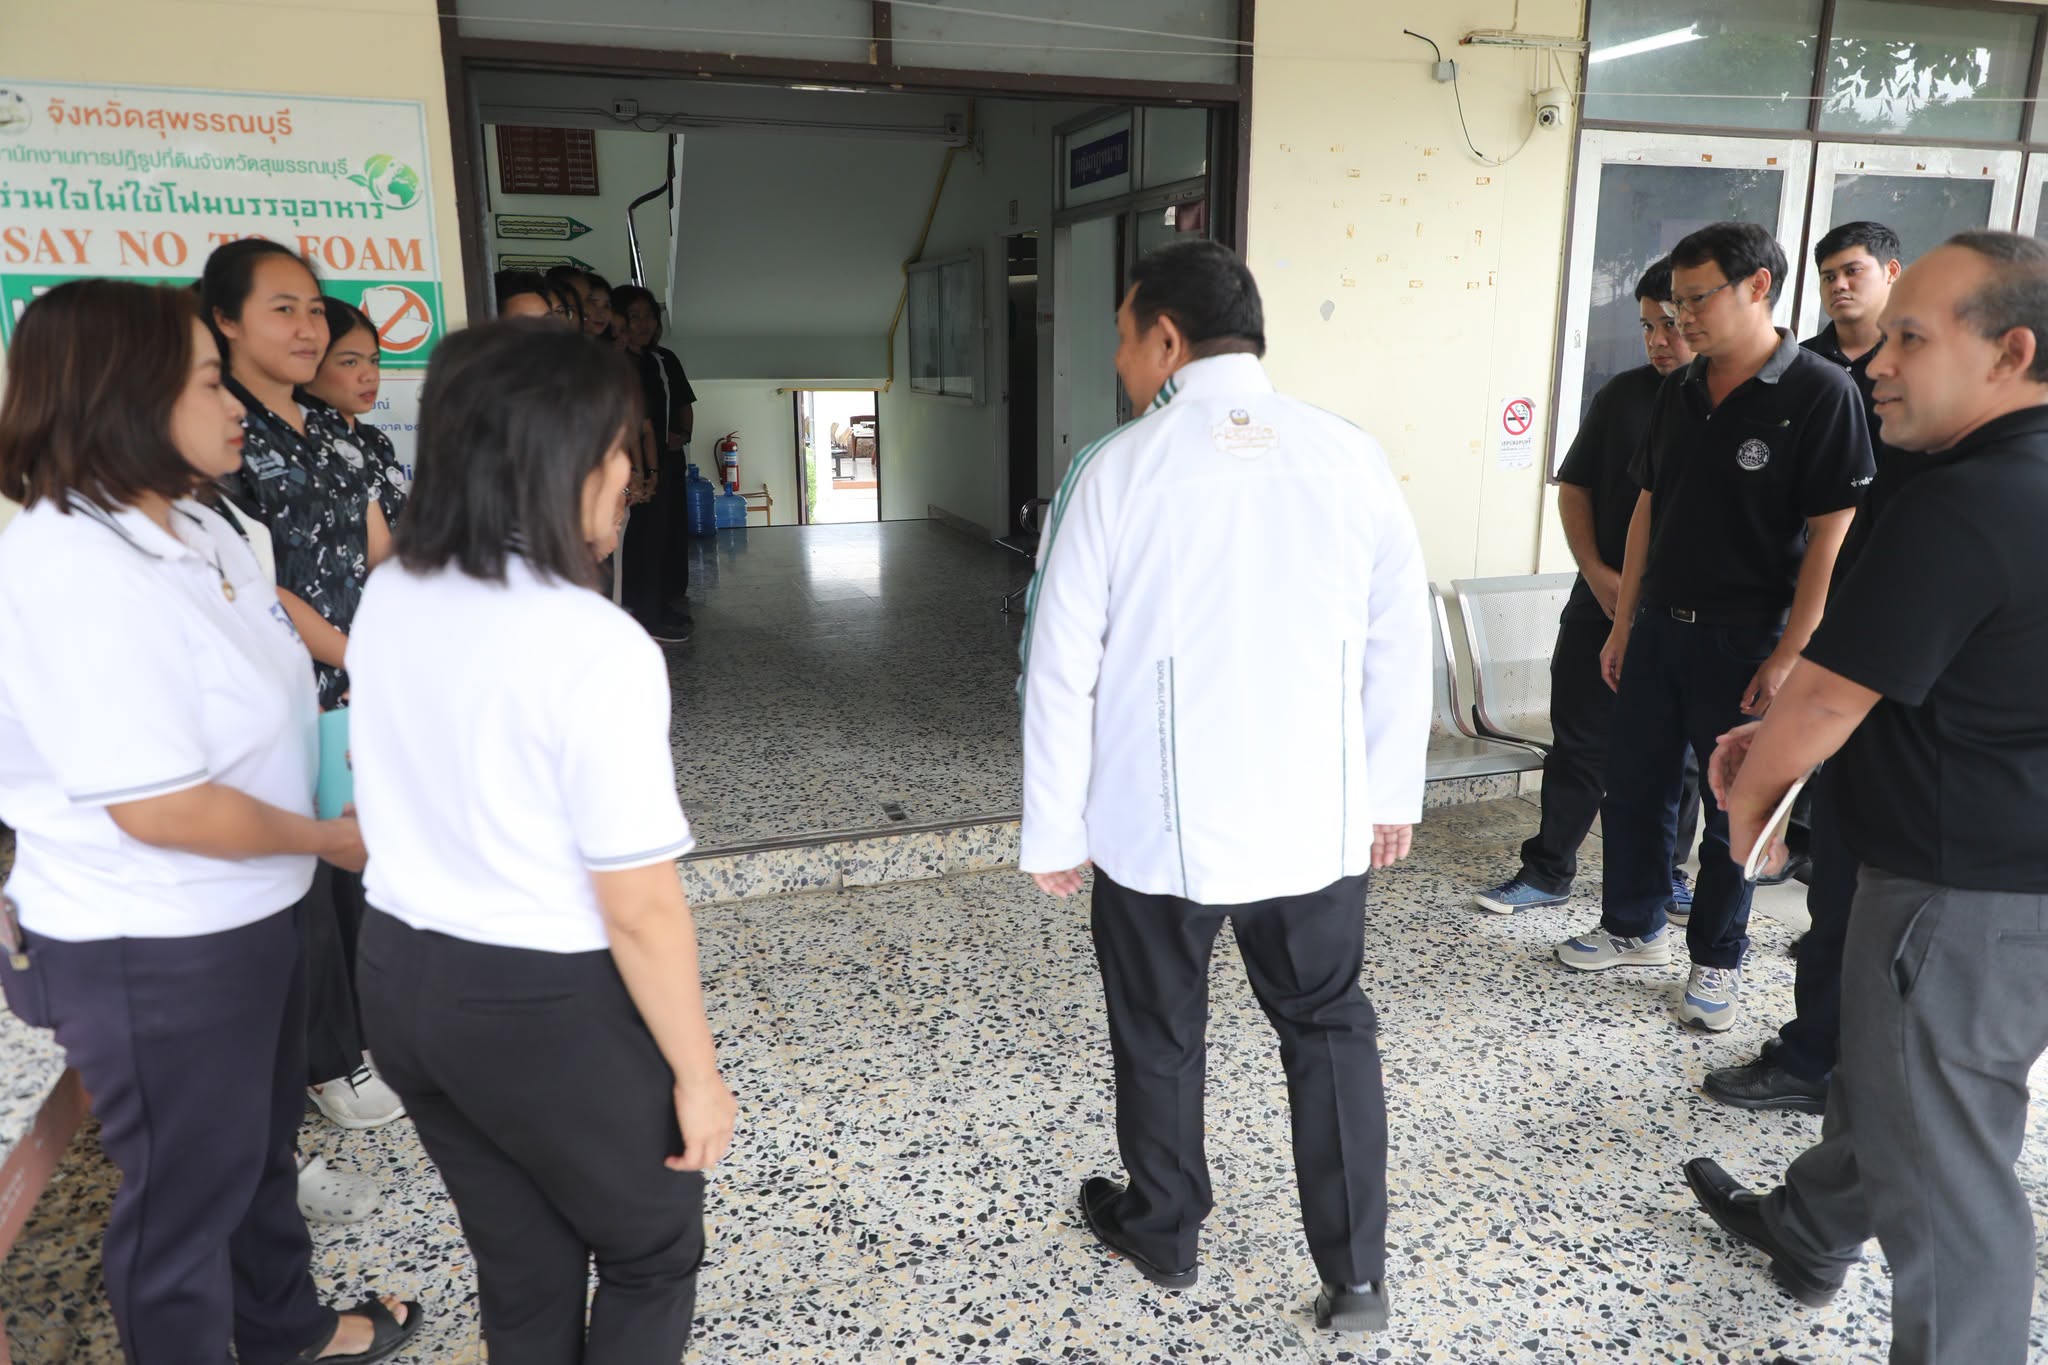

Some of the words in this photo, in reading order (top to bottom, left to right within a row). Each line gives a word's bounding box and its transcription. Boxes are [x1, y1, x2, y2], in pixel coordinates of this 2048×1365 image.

[48, 97, 293, 144] จังหวัดสุพรรณบุรี
[0, 144, 348, 179] ำนักงานการปฏิรูปที่ดินจังหวัดสุพรรณบุรี
[0, 177, 384, 227] ร่วมใจไม่ใช้โฟมบรรจุอาหาร
[2, 226, 93, 265] SAY
[115, 230, 188, 268] NO
[296, 235, 426, 272] FOAM
